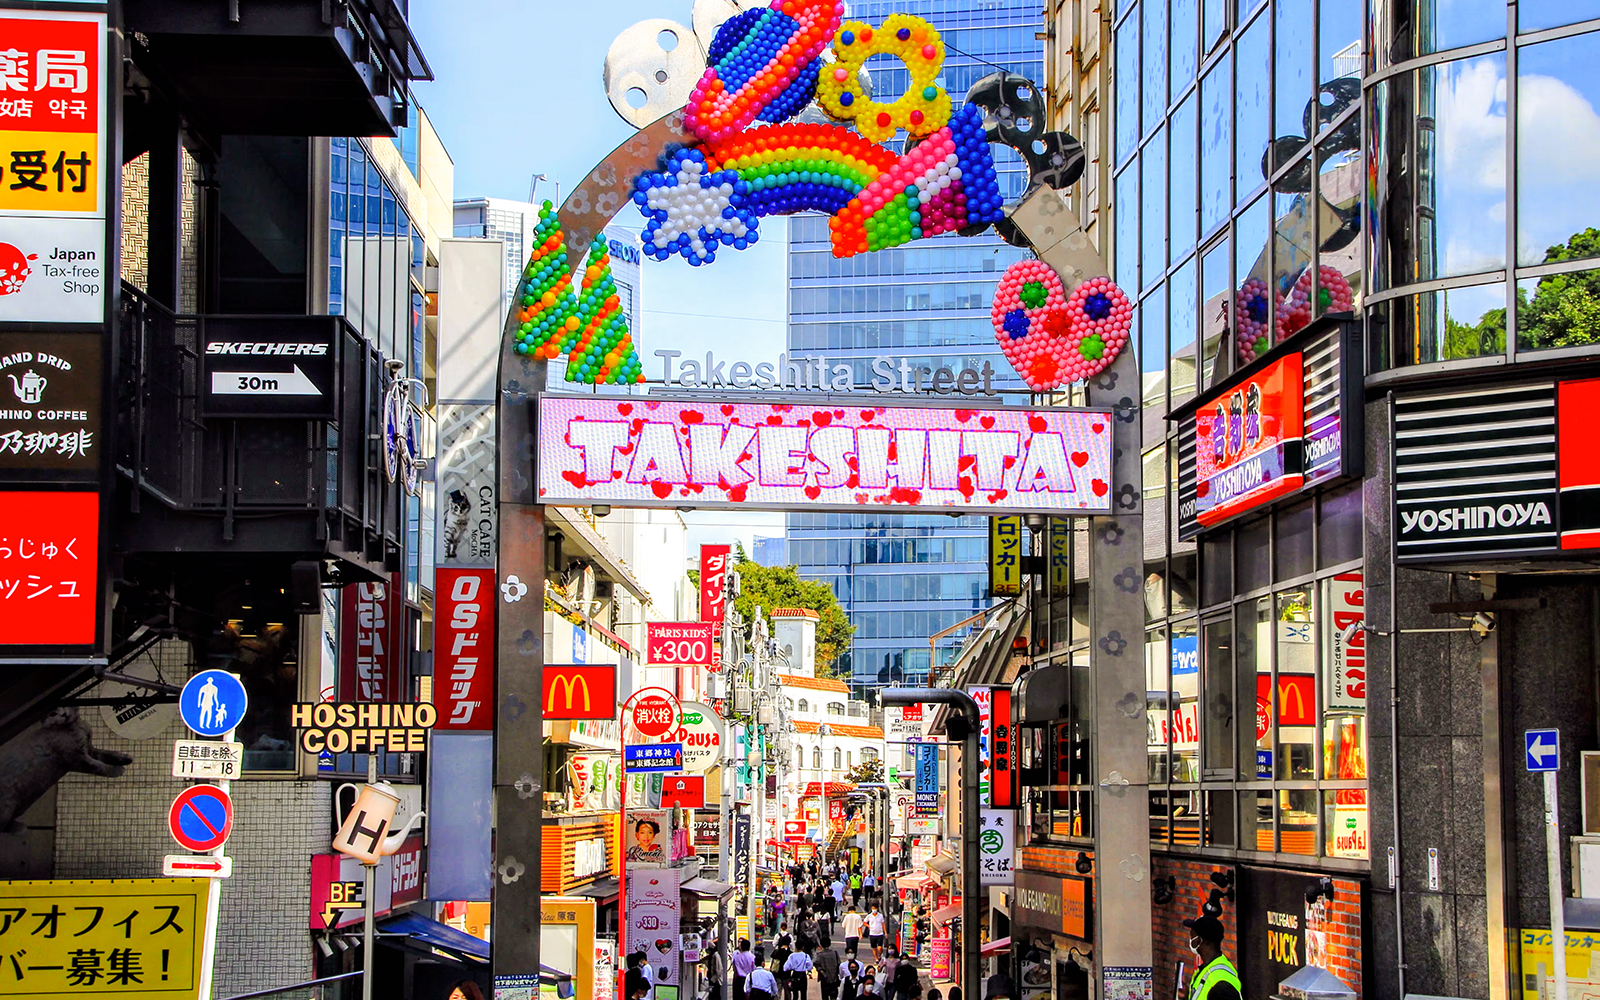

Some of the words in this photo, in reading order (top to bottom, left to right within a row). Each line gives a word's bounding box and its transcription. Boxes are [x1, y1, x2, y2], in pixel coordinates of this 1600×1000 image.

[49, 99, 88, 119] 약국
[0, 150, 92, 192] 受付
[49, 247, 96, 264] Japan
[42, 264, 100, 279] Tax-free
[63, 280, 100, 296] Shop
[205, 341, 328, 356] SKECHERS
[0, 352, 33, 370] AND
[37, 352, 72, 371] DRIP
[654, 349, 854, 391] Takeshita
[871, 354, 996, 397] Street
[237, 376, 278, 391] 30m
[37, 410, 88, 420] COFFEE
[567, 418, 1077, 493] TAKESHITA
[1305, 430, 1340, 464] YOSHINOYA
[1214, 457, 1262, 503] YOSHINOYA
[479, 485, 493, 517] CAT
[1402, 502, 1551, 534] YOSHINOYA
[479, 519, 493, 558] CAFE
[654, 626, 681, 638] PARIS
[449, 575, 481, 724] OSドラッグ
[653, 641, 706, 662] ¥300
[291, 703, 437, 727] HOSHINO
[636, 707, 671, 724] 消火栓
[302, 729, 427, 752] COFFEE
[678, 728, 719, 748] Pausa
[178, 744, 238, 760] 自転車を除く
[221, 762, 234, 775] 18
[330, 883, 356, 903] BF
[1266, 910, 1299, 930] WOLFGANG
[1267, 930, 1299, 966] PUCK
[1523, 932, 1600, 949] コインッカー
